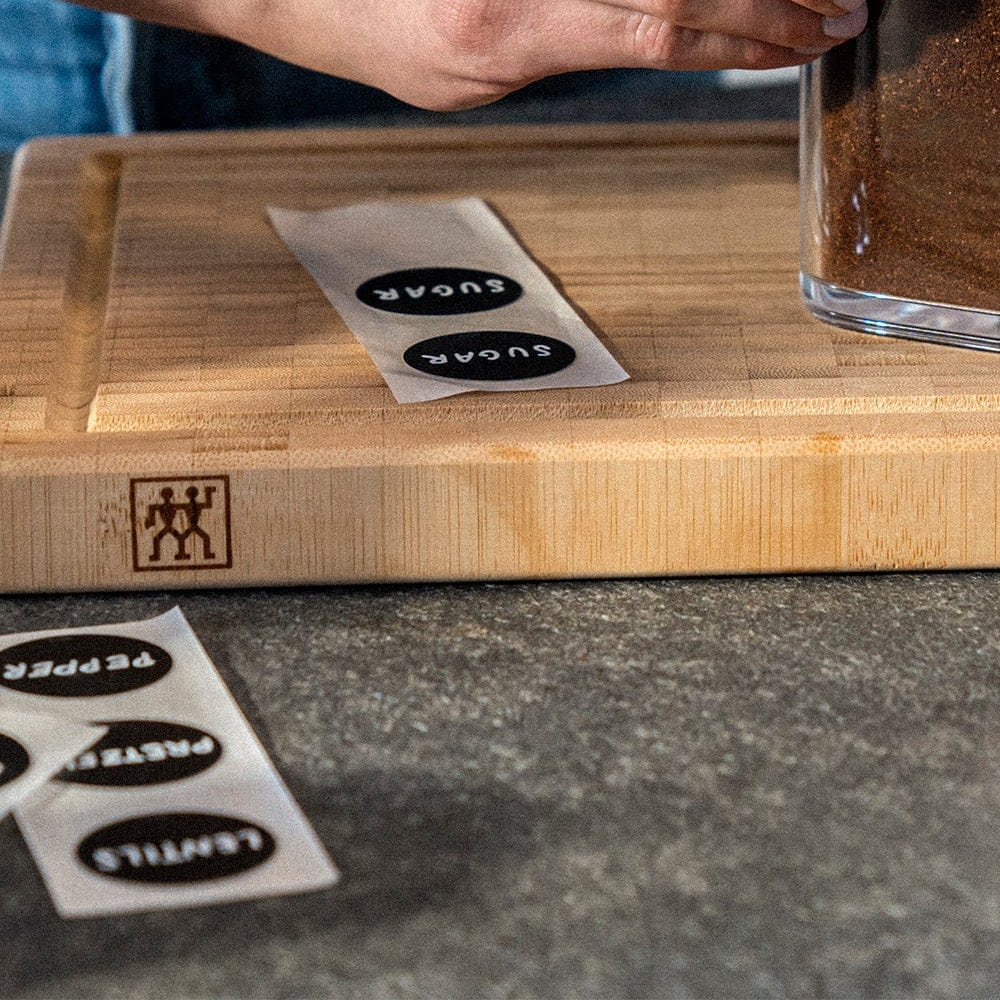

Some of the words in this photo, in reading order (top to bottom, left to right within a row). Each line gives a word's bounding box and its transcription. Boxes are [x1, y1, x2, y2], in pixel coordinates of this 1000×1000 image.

[373, 279, 505, 301] SUGAR
[422, 344, 552, 365] SUGAR
[3, 651, 156, 680] PEPPER
